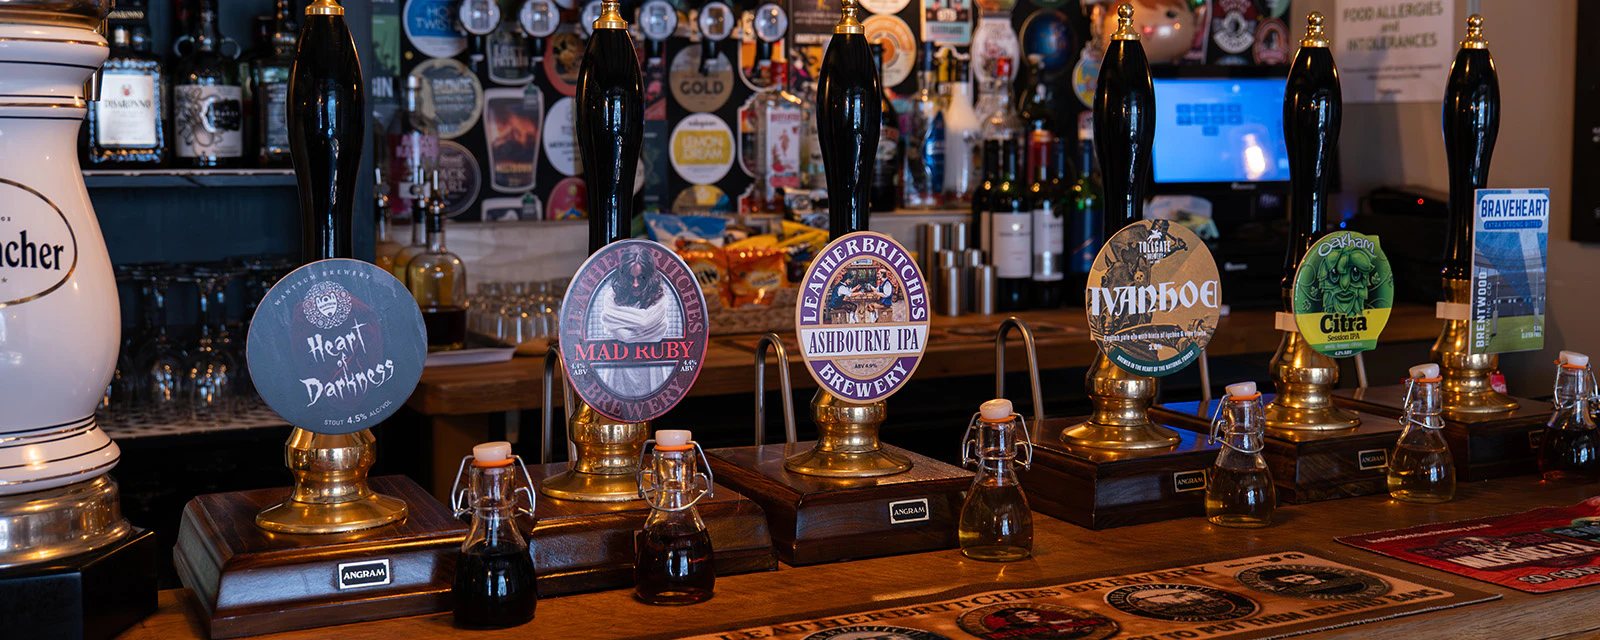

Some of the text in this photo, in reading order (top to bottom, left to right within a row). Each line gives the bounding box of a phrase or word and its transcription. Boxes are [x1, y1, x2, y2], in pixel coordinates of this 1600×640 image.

[1343, 1, 1444, 22] FOOD ALLERGIES
[1346, 31, 1438, 50] INTOLERANCES
[680, 81, 724, 95] GOLD
[1481, 199, 1548, 218] BRAVEHEART
[1485, 221, 1501, 229] EXTRA
[1524, 220, 1543, 228] BITTER
[0, 229, 64, 270] cher
[1138, 240, 1171, 253] TOLLGATE
[1318, 232, 1375, 256] Oakham
[274, 269, 371, 306] WANTSUM BREWERY
[803, 237, 926, 322] LEATHERBRITCHES
[1475, 271, 1487, 348] BRENTWOOD
[1320, 313, 1367, 334] Citra
[307, 318, 367, 363] Heart
[809, 328, 919, 354] ASHBOURNE IPA
[1350, 332, 1360, 340] IPA
[337, 352, 349, 370] of
[574, 341, 694, 361] MAD RUBY
[1117, 354, 1131, 367] BREWED
[300, 359, 395, 407] Darkness
[819, 360, 908, 397] BREWERY
[583, 377, 685, 418] BREWERY
[347, 412, 367, 424] 4.5%
[369, 399, 392, 417] ALC/VOL
[894, 507, 925, 515] ANGRAM
[343, 568, 385, 580] ANGRAM
[1517, 574, 1554, 584] SO
[715, 588, 1062, 640] LEATHERBRITCHES
[1065, 566, 1214, 593] BREWERY
[1161, 589, 1443, 639] TO PUT THEM BEHIND BARS
